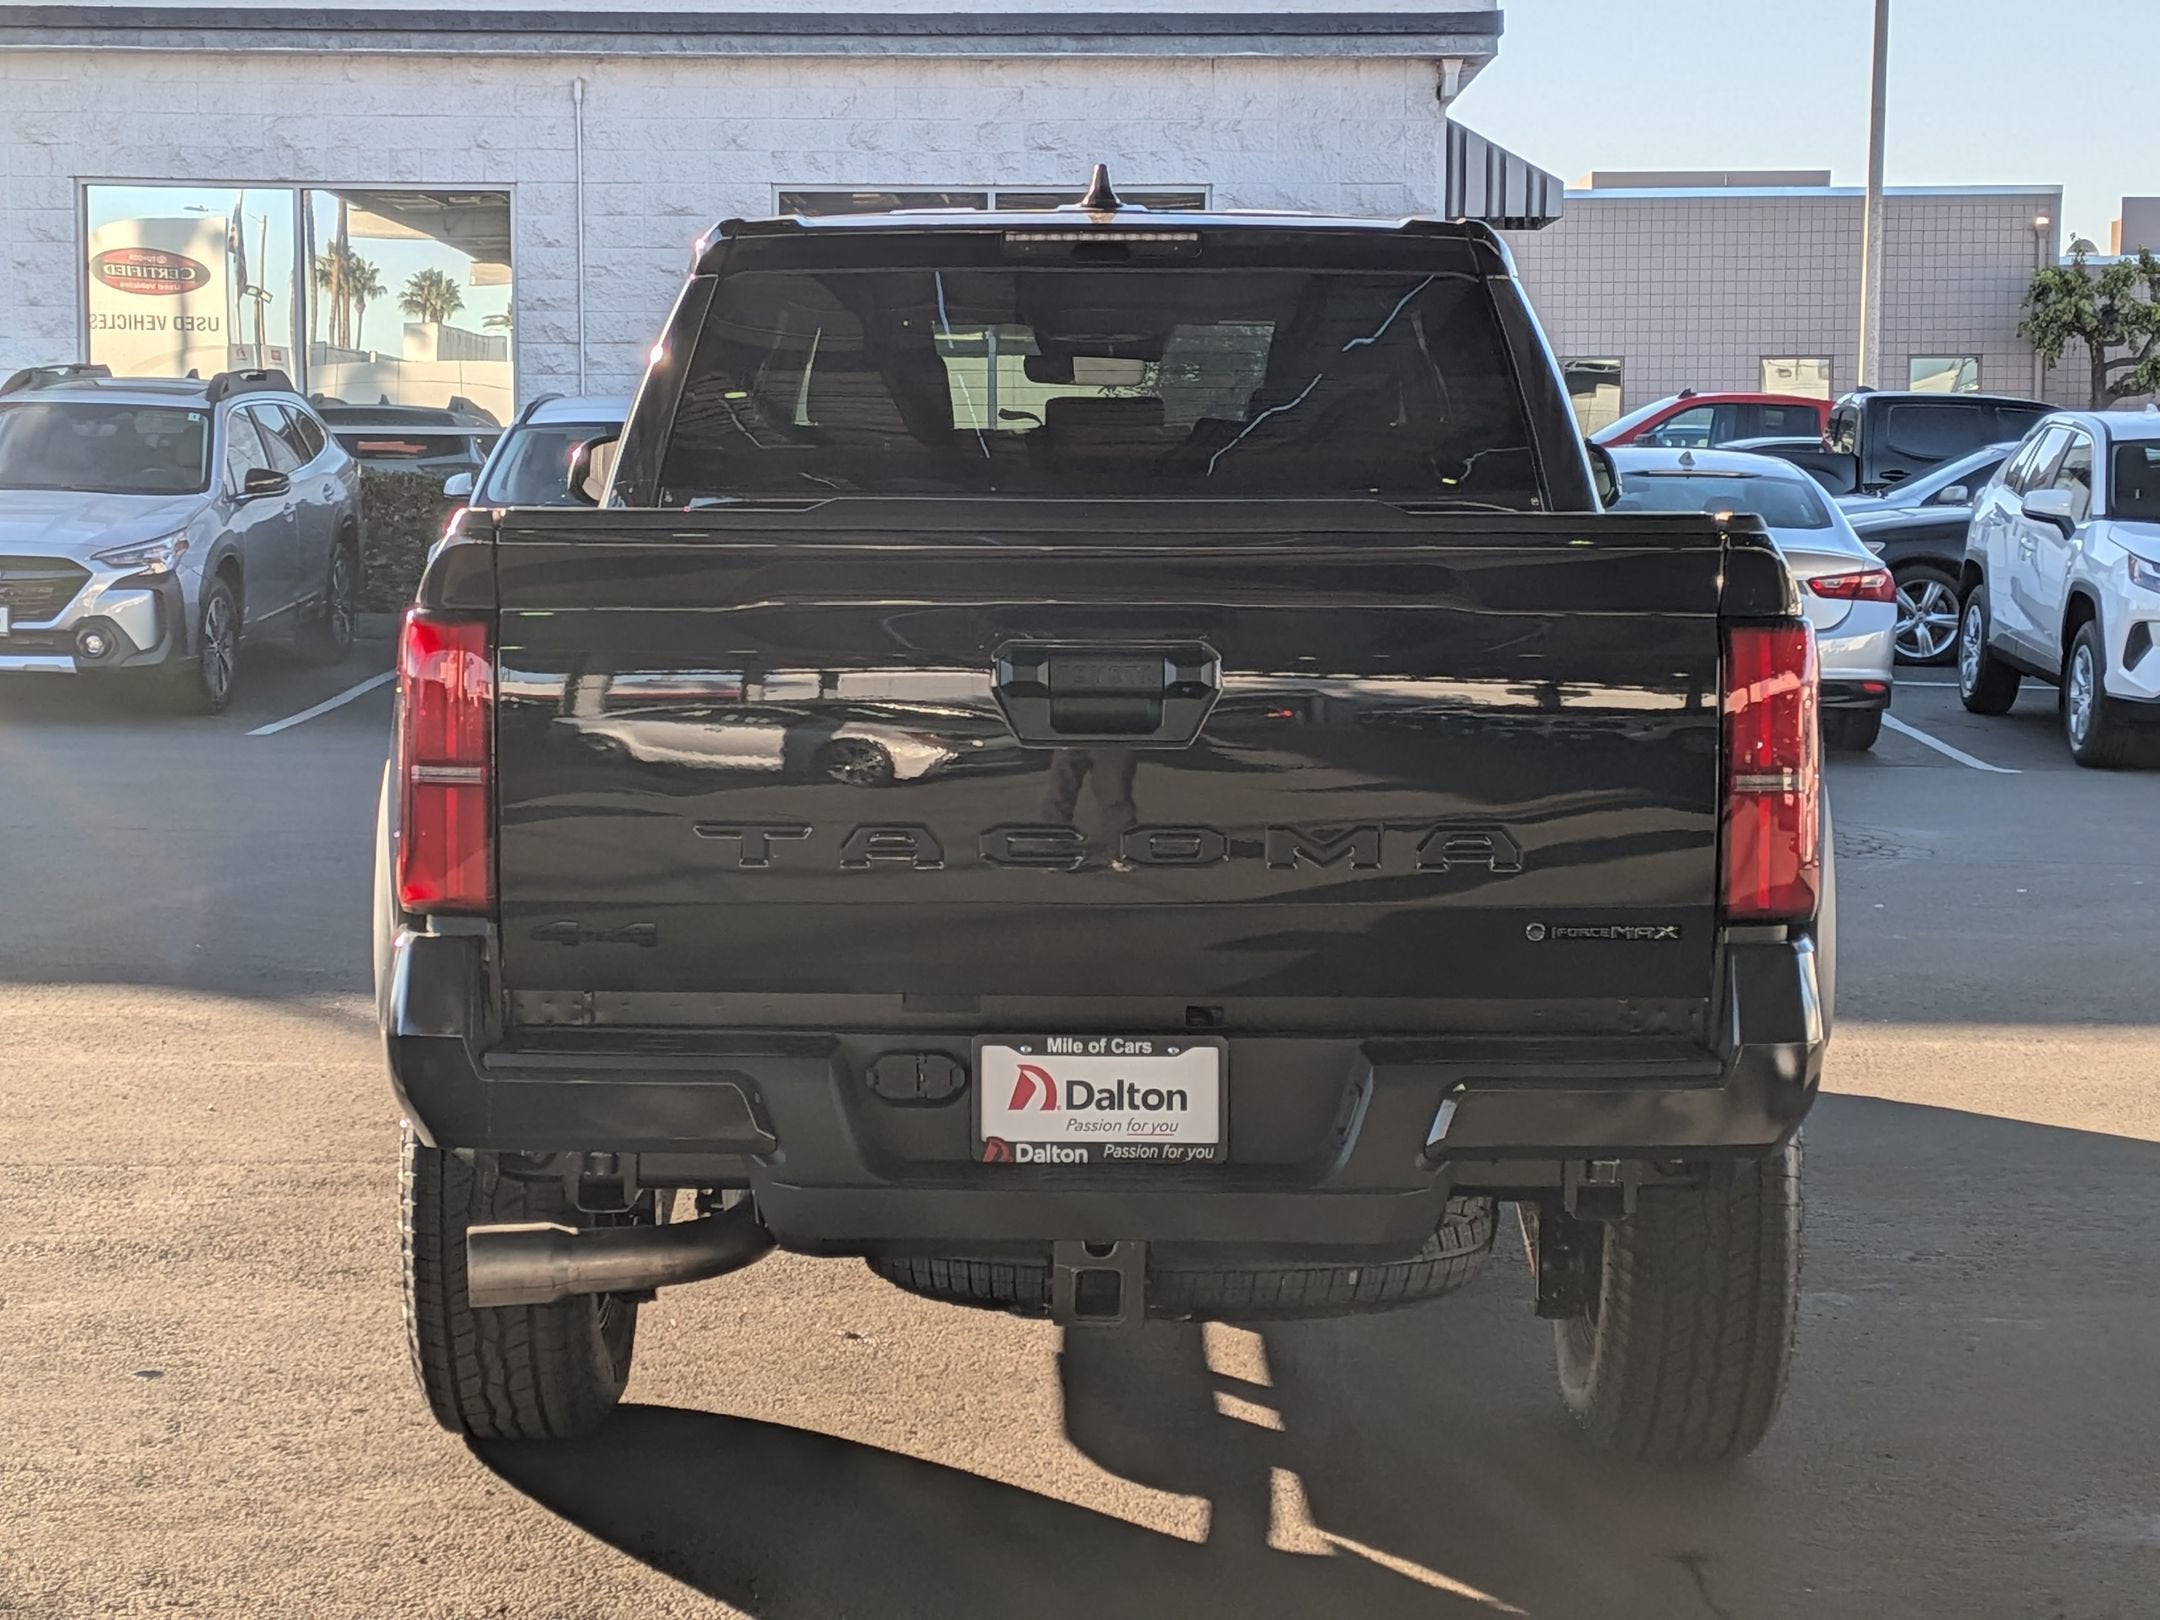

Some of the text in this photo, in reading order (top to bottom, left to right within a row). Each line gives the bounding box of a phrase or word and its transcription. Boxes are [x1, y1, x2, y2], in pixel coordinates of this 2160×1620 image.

[693, 821, 1523, 874] TACOMA
[1047, 1037, 1153, 1054] Mile of Cars
[1066, 1079, 1188, 1112] Dalton
[1066, 1118, 1179, 1135] Passion for you
[1016, 1144, 1088, 1164] Dalton
[1103, 1144, 1214, 1162] Passion for you
